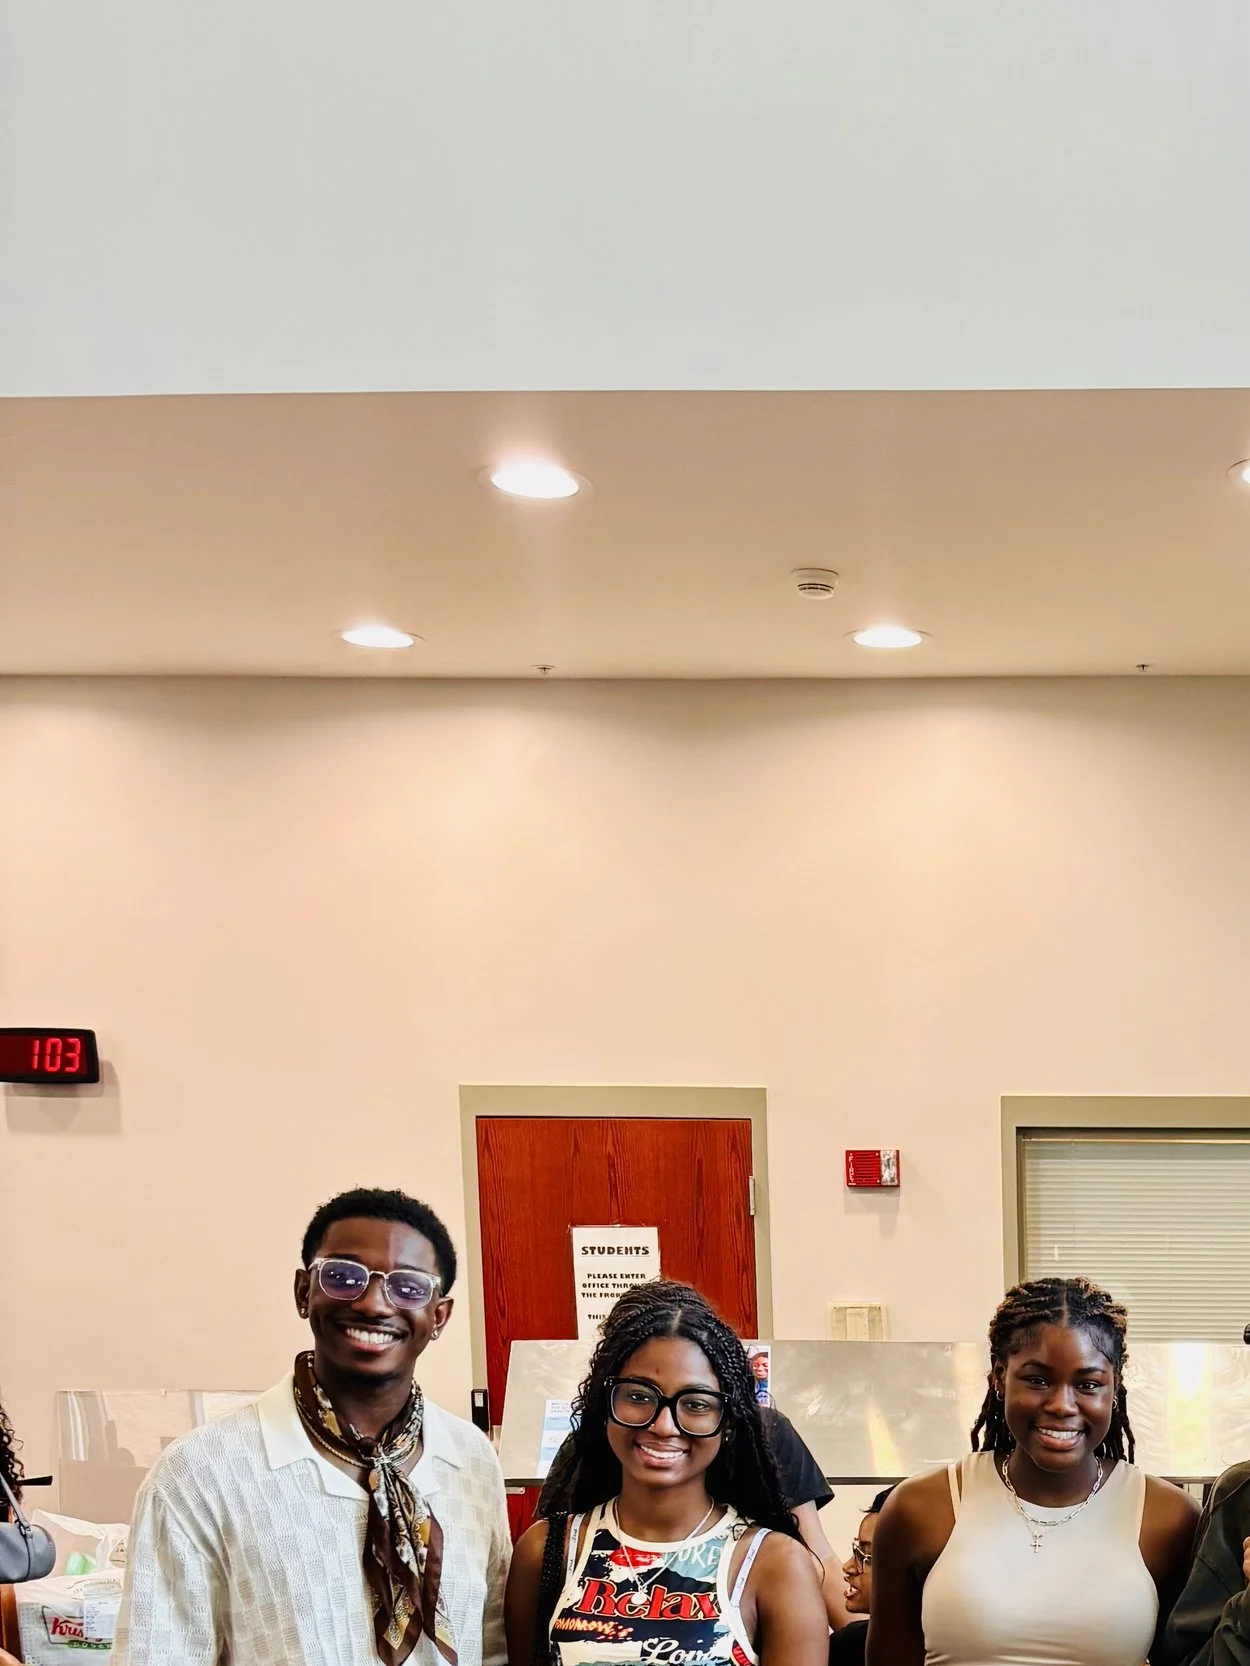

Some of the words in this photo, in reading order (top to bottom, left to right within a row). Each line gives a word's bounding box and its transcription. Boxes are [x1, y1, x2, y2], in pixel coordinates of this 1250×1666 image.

[32, 1037, 81, 1072] 103
[581, 1246, 650, 1256] STUDENTS
[573, 1577, 722, 1620] Relax
[50, 1616, 84, 1639] Kris
